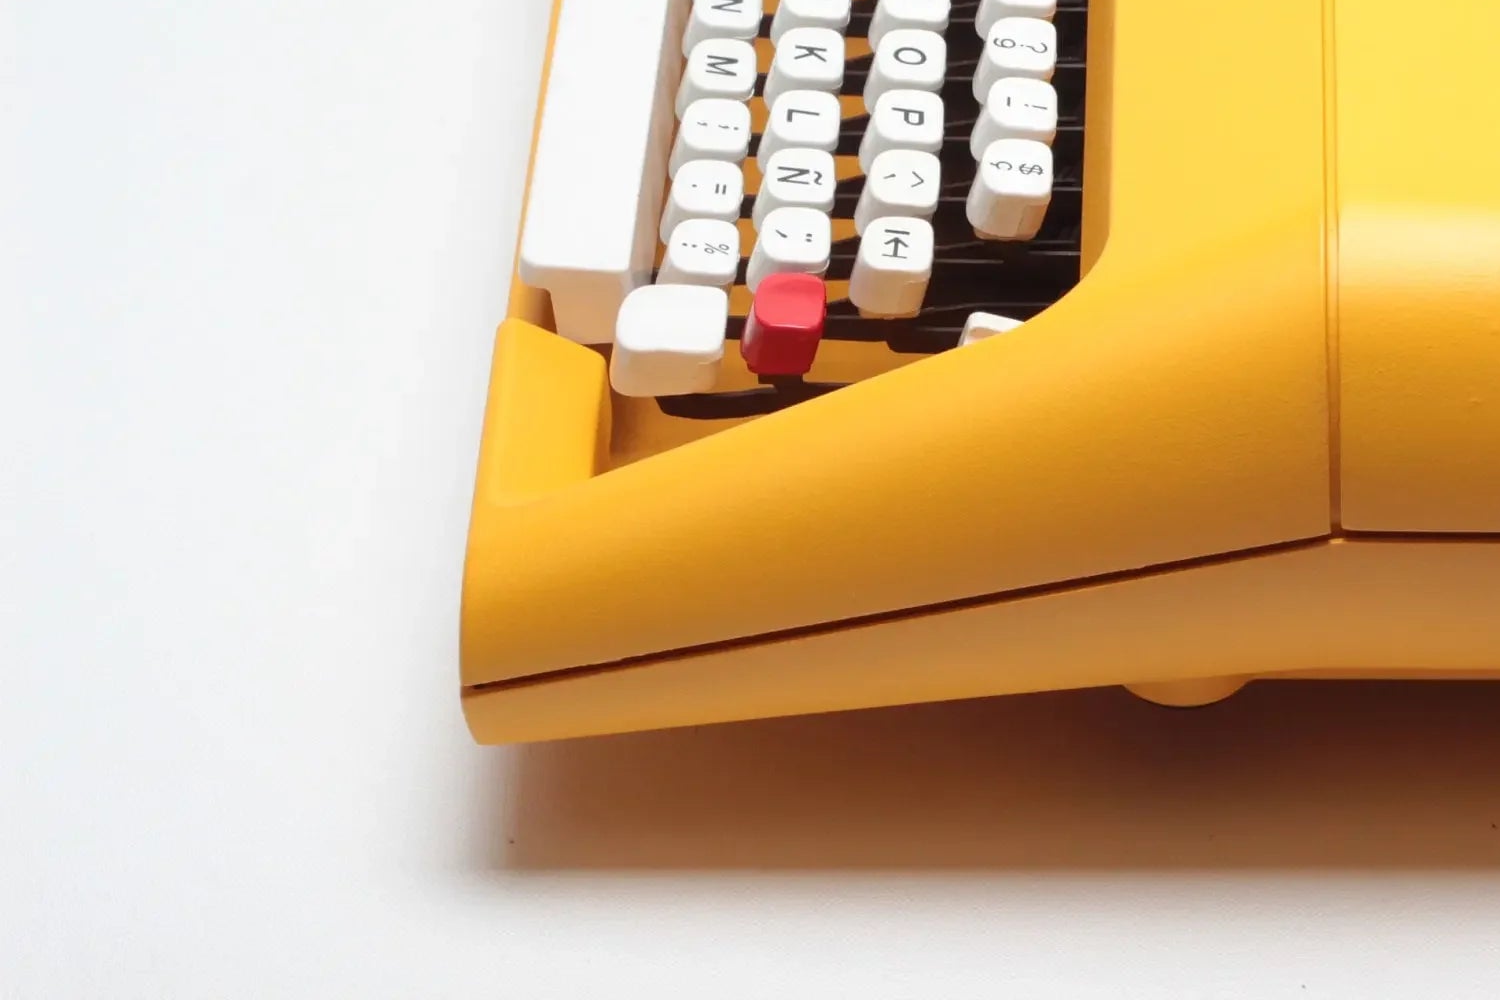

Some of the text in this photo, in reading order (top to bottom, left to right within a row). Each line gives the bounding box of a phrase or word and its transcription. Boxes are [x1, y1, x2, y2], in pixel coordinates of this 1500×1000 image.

[992, 37, 1017, 49] 9
[1018, 42, 1048, 54] ?
[794, 45, 827, 62] K
[893, 47, 926, 65] O
[706, 55, 738, 76] M
[787, 109, 820, 122] L
[892, 108, 924, 126] P
[777, 167, 822, 185] Ñ
[1018, 163, 1044, 176] $
[704, 243, 729, 255] %
